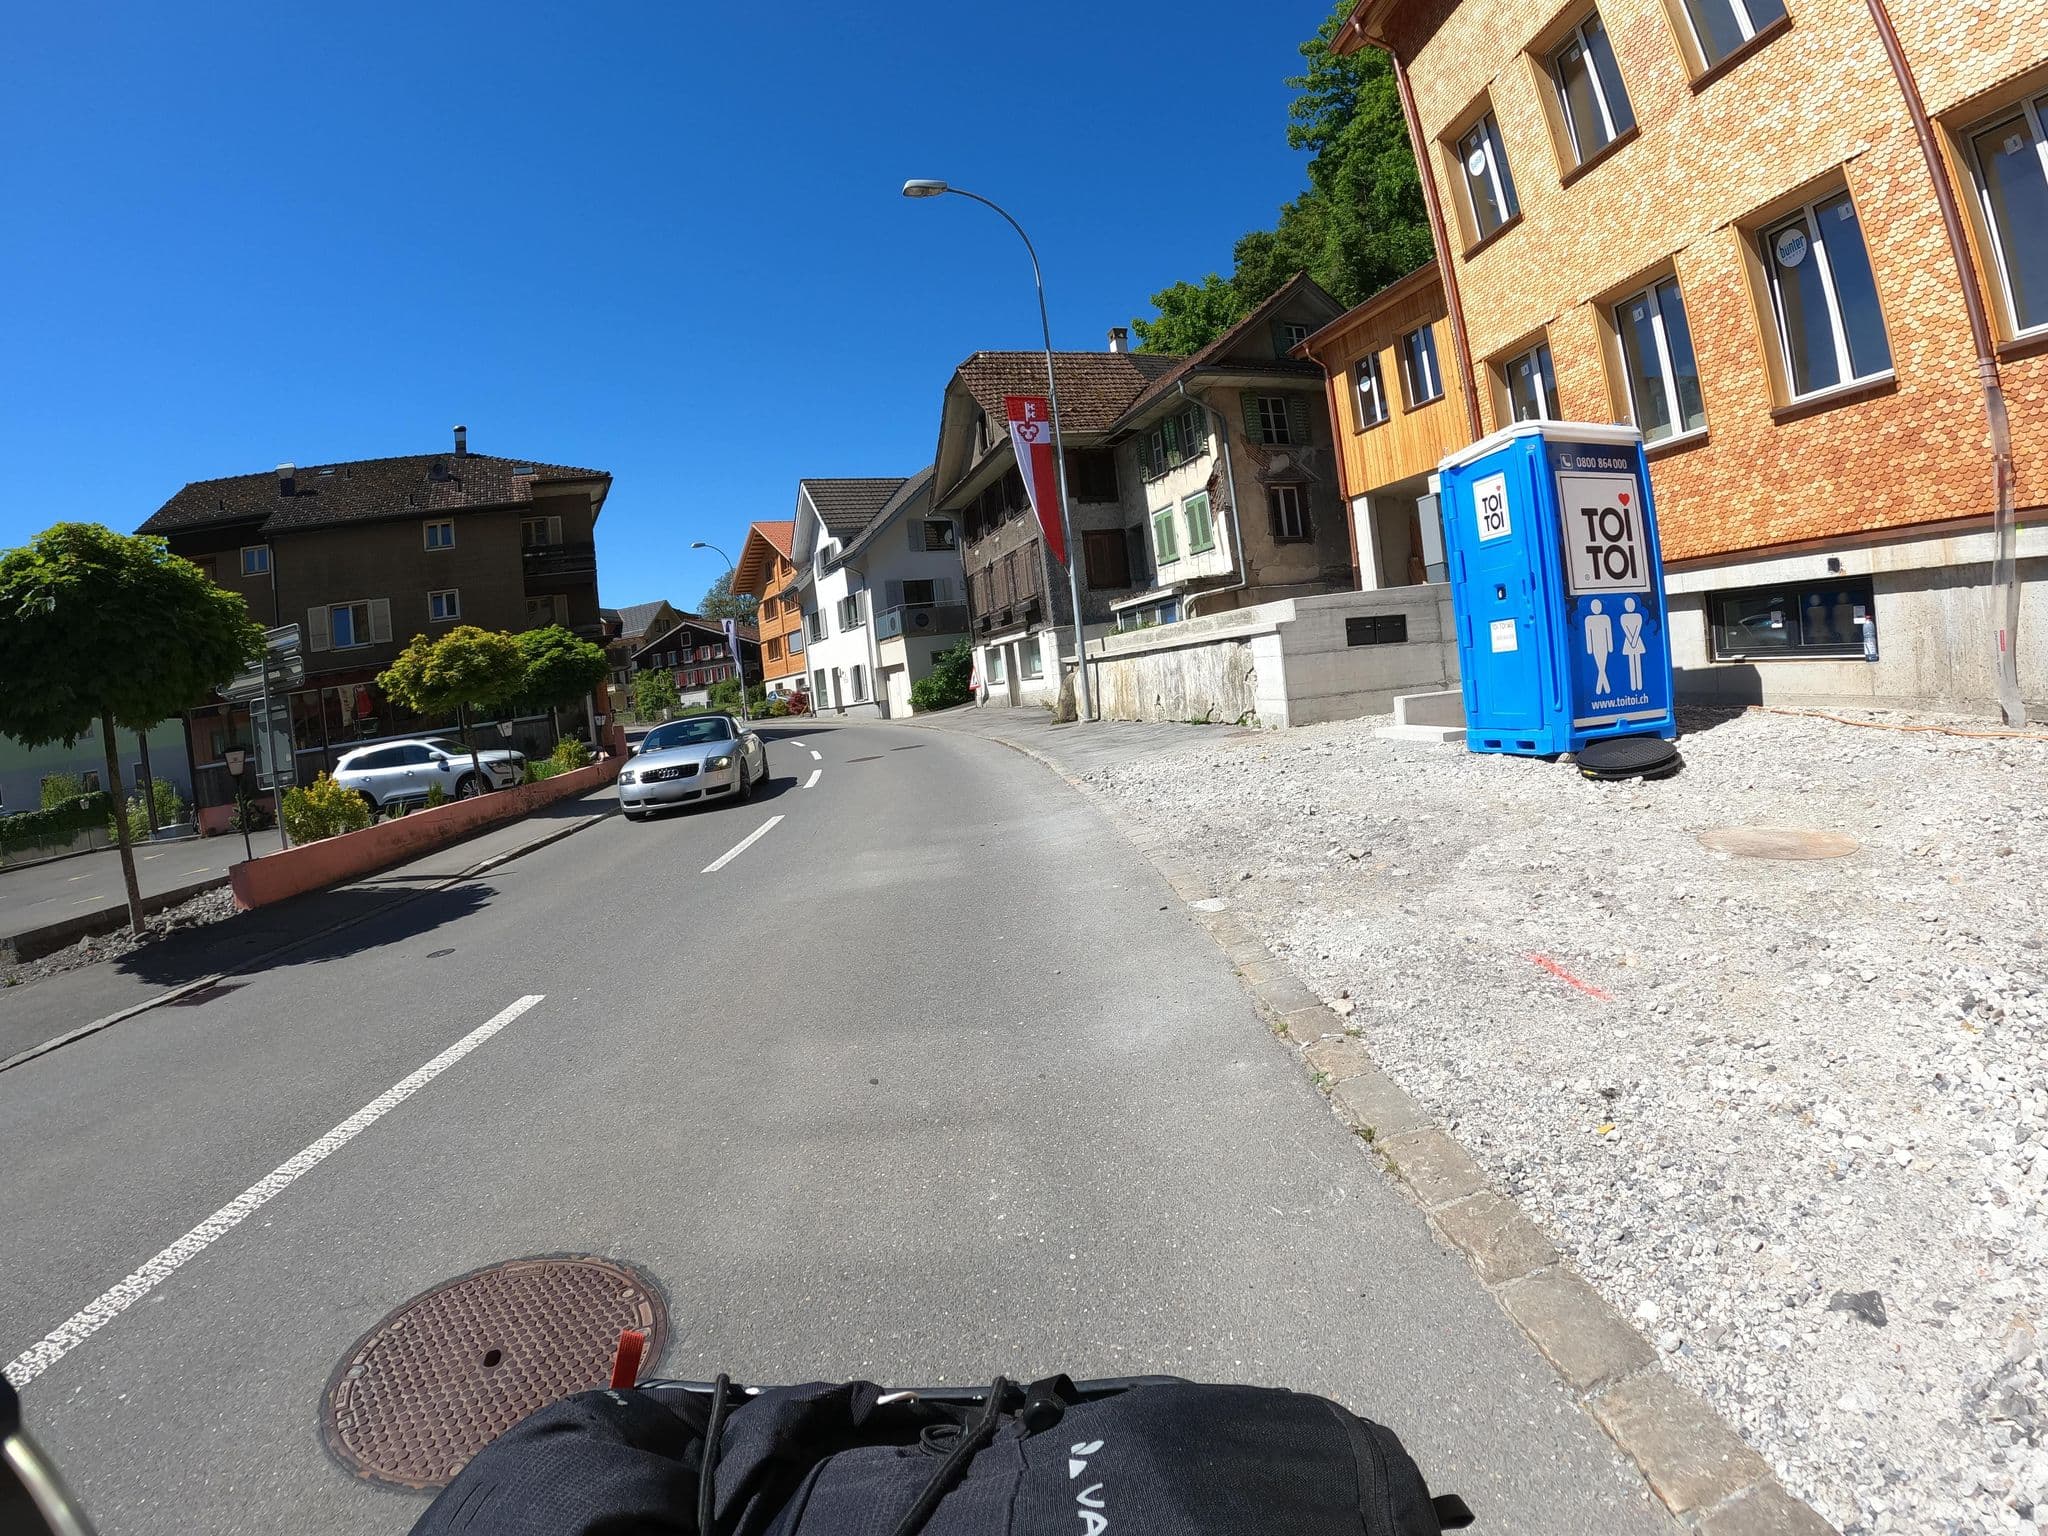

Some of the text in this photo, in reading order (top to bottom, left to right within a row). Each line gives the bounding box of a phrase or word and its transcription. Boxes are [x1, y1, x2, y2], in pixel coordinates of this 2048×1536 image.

[1576, 457, 1627, 469] 0800 864 000
[1482, 492, 1502, 514] TOI
[1484, 511, 1505, 532] TOI
[1580, 507, 1633, 543] TOI
[1585, 544, 1638, 580] TOI
[1591, 693, 1649, 710] www.toitoi.ch
[1075, 1482, 1108, 1536] VA
